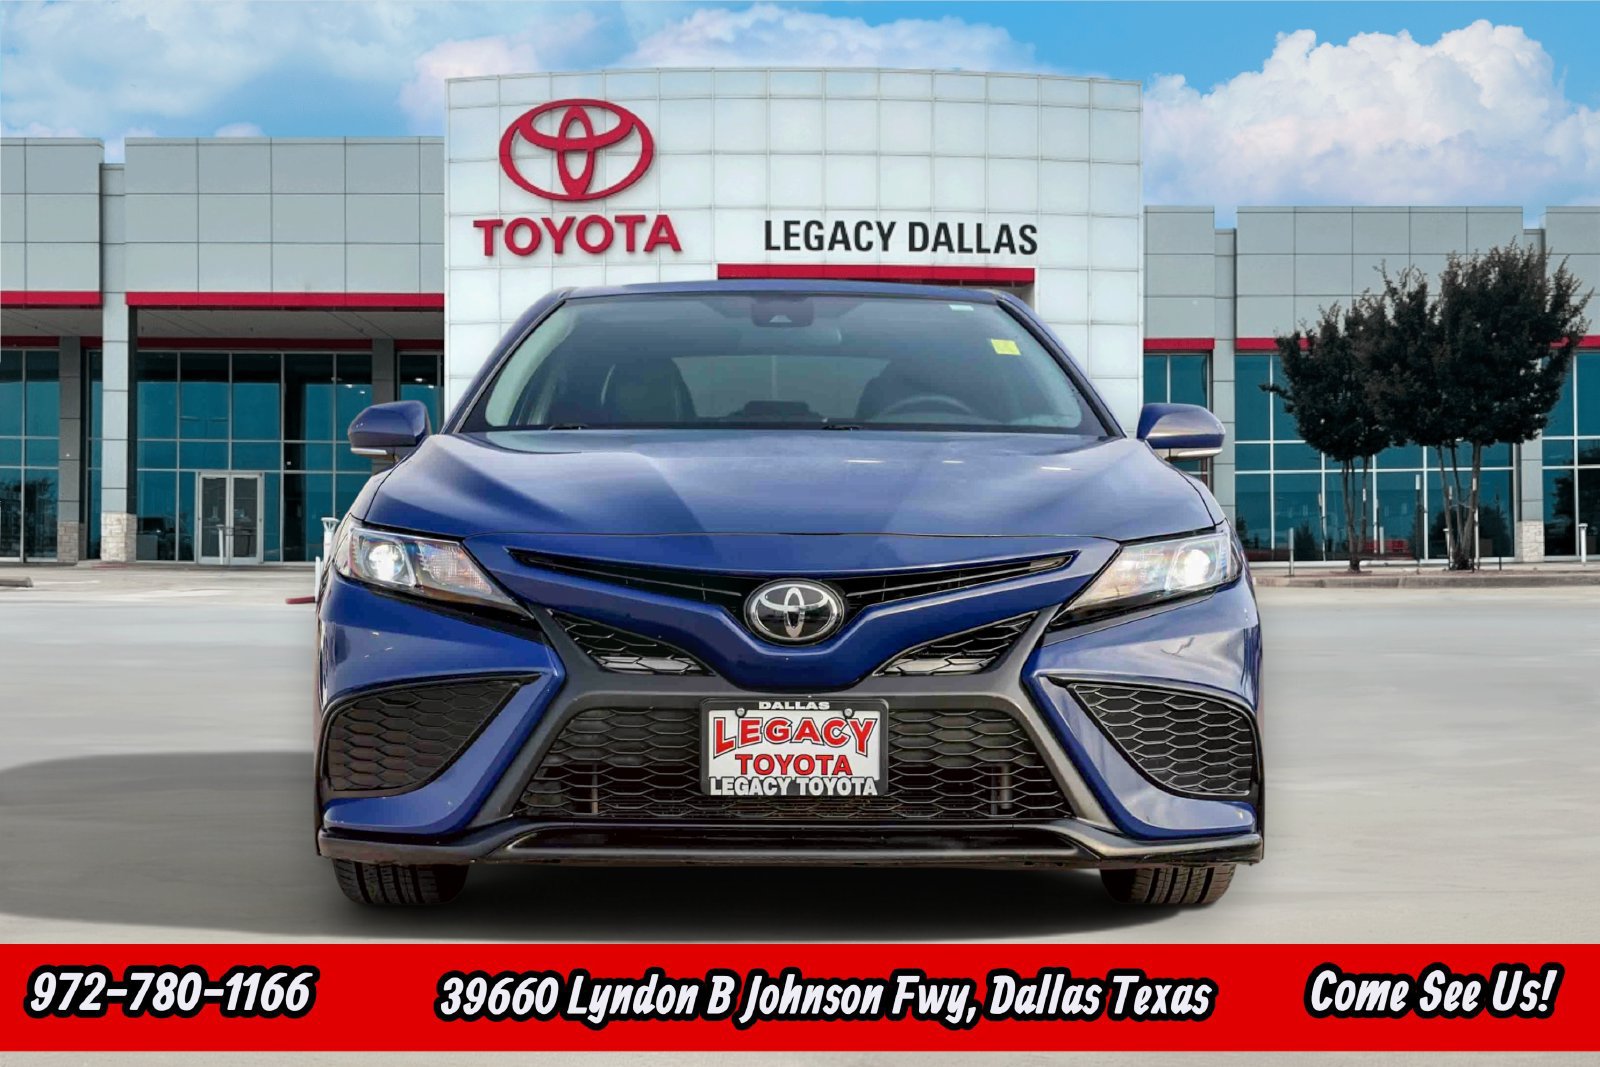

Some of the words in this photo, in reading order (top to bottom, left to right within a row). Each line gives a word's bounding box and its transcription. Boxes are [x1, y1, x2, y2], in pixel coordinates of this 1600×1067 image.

[473, 214, 682, 257] TOYOTA
[765, 220, 896, 252] LEGACY
[908, 221, 1038, 255] DALLAS
[758, 701, 830, 710] DALLAS
[713, 717, 877, 759] LEGACY
[735, 753, 853, 776] TOYOTA
[710, 776, 792, 796] LEGACY
[795, 776, 878, 796] TOYOTA
